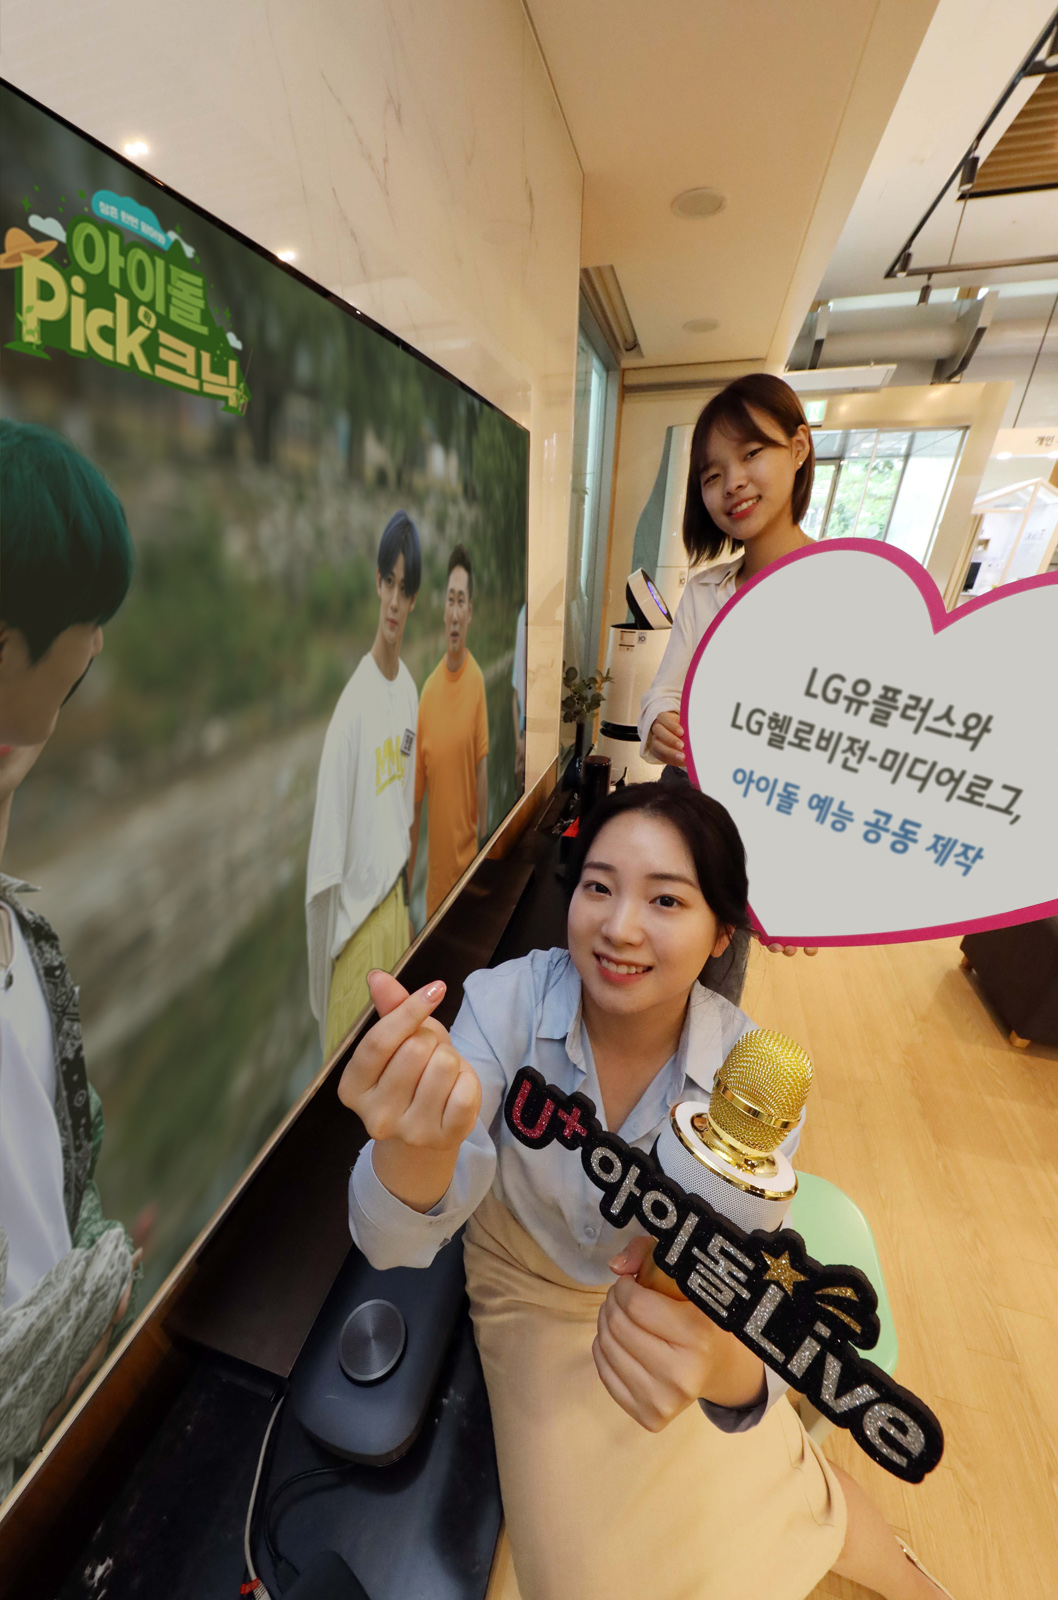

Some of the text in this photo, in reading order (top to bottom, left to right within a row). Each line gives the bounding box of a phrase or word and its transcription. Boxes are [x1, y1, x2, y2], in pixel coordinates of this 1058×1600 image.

[72, 222, 209, 336] 아이돌
[731, 702, 1023, 825] LG헬로비전-미디어로그,
[804, 667, 993, 752] LG유플러스와
[732, 768, 984, 877] 아이돌 예능 공동 제작
